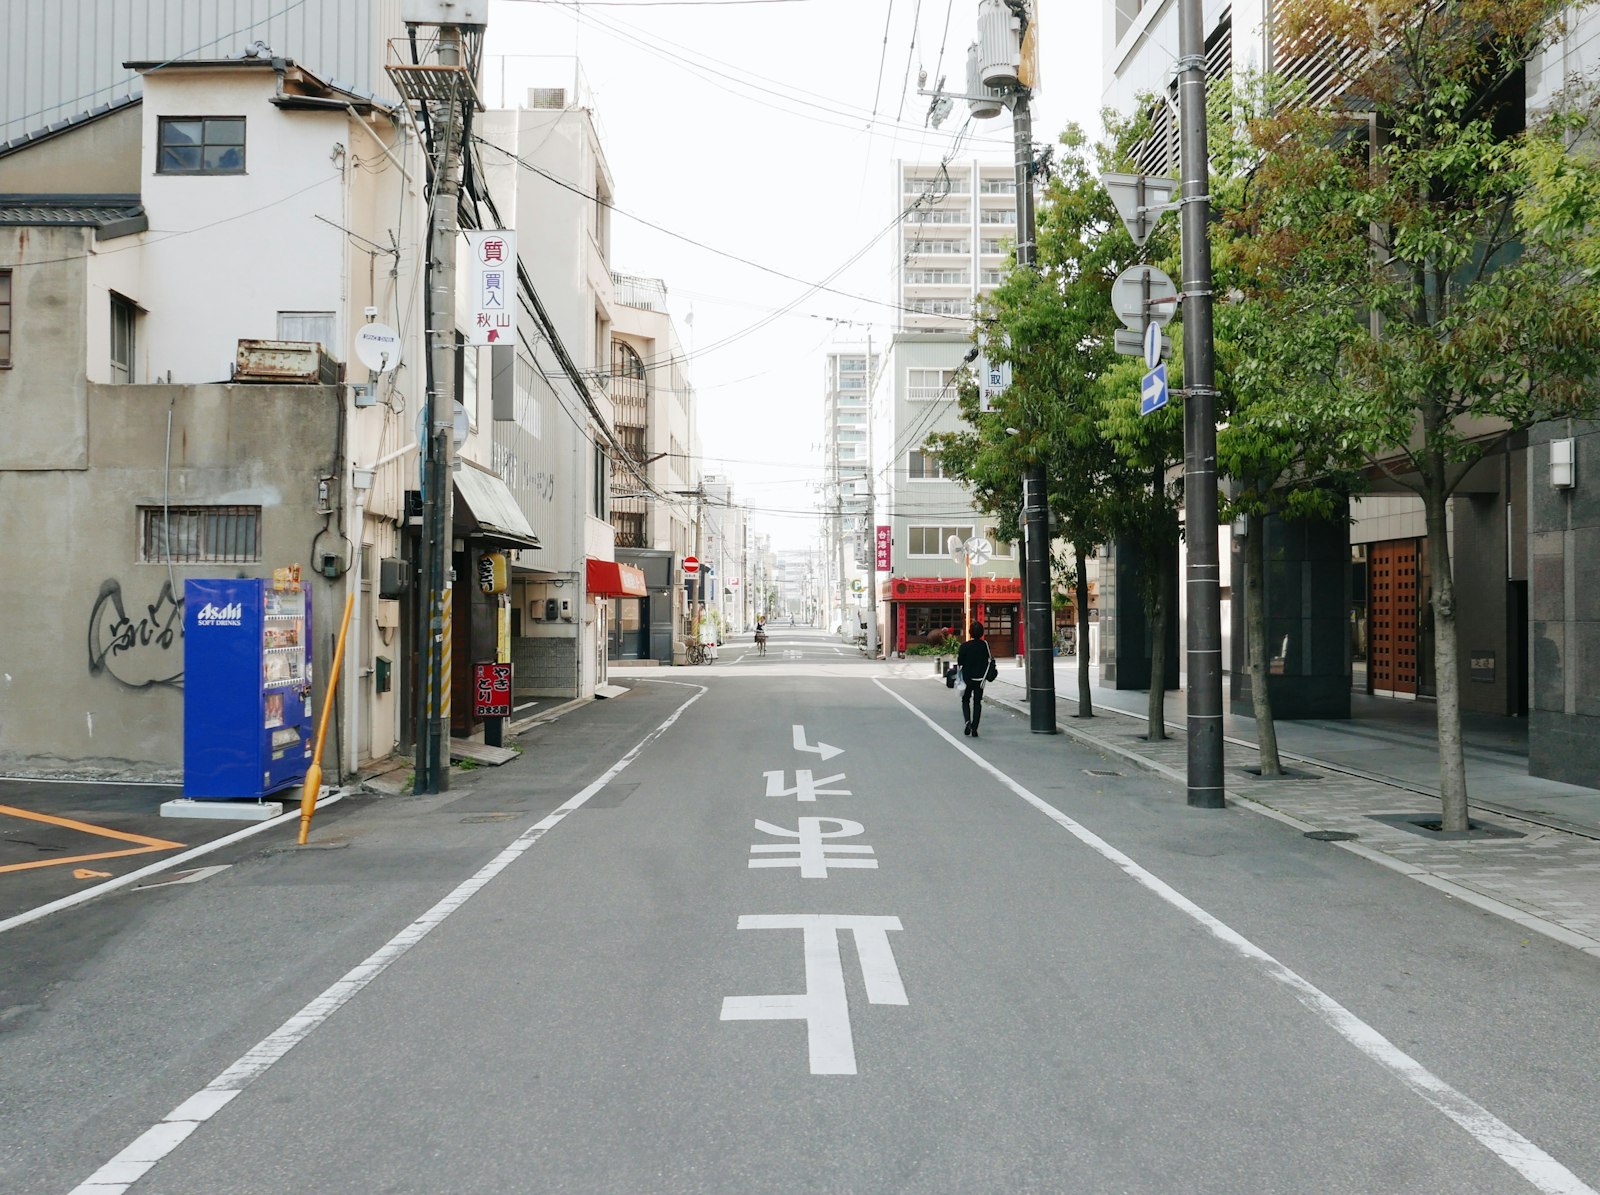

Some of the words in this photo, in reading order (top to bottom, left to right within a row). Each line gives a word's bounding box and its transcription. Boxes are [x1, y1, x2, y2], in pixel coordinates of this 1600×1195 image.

[484, 241, 503, 262] 質
[486, 273, 501, 306] 買入
[477, 312, 510, 328] 秋山
[198, 602, 242, 620] Asahi
[477, 678, 492, 703] とり
[493, 666, 510, 692] やき
[720, 769, 910, 1076] 止まれ
